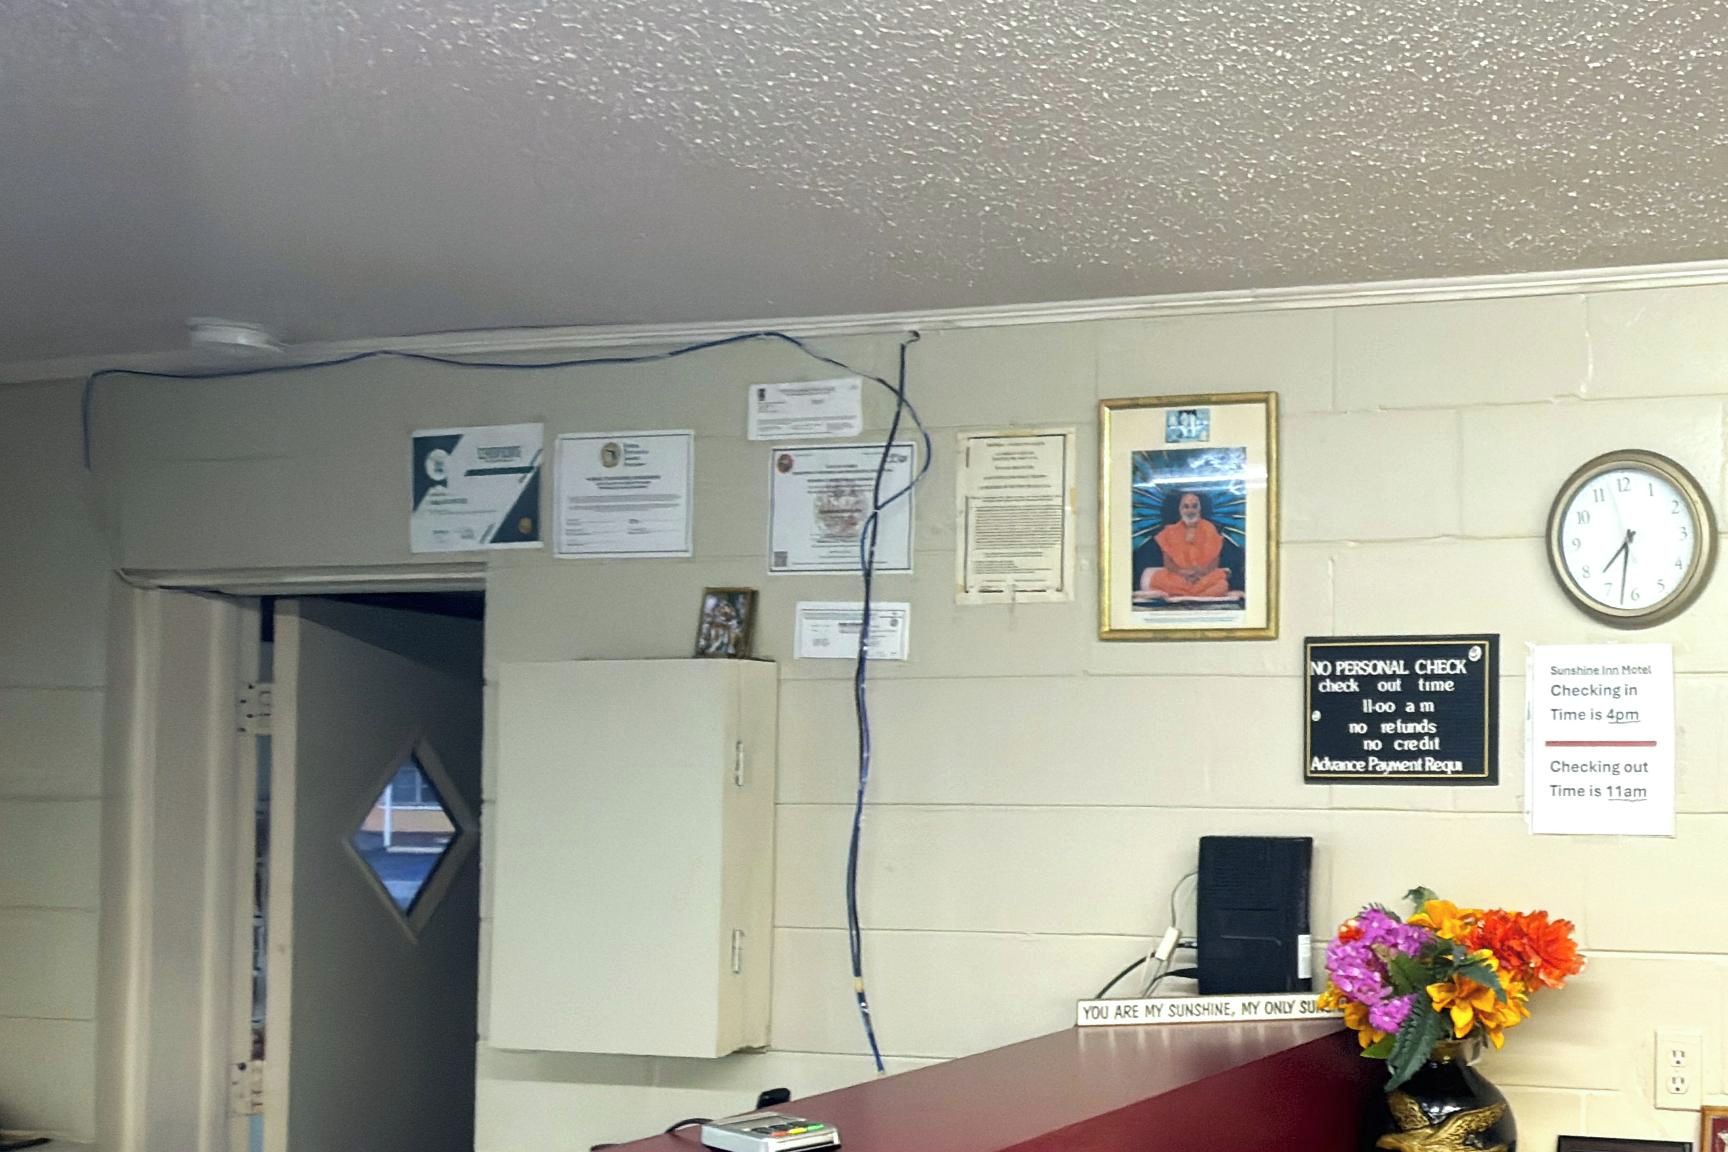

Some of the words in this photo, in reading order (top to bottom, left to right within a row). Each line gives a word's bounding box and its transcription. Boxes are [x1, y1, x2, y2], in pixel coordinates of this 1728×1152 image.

[1617, 477, 1631, 492] 12
[1648, 483, 1654, 497] 1
[1593, 488, 1605, 503] 11
[1671, 500, 1680, 514] 2
[1576, 510, 1591, 524] 10
[1680, 526, 1688, 541] 3
[1572, 537, 1582, 550] 9
[1675, 558, 1683, 570] 4
[1582, 565, 1591, 579] 8
[1604, 582, 1613, 597] 7
[1657, 579, 1665, 591] 5
[1631, 587, 1640, 601] 6
[1311, 661, 1332, 675] NO
[1336, 660, 1409, 675] PERSONAL
[1415, 659, 1467, 675] CHECK
[1550, 665, 1600, 675] Sunshine
[1602, 665, 1619, 675] Inn
[1622, 665, 1652, 675] Motel
[1318, 678, 1360, 693] check
[1377, 679, 1402, 692] out
[1418, 678, 1455, 692] time
[1550, 684, 1621, 699] Checking
[1624, 684, 1638, 696] in
[1405, 702, 1415, 713] a
[1420, 701, 1435, 713] m
[1550, 708, 1586, 721] Time
[1590, 708, 1602, 721] is
[1606, 708, 1639, 723] 4pm
[1349, 722, 1368, 734] no
[1380, 719, 1438, 734] refunds
[1363, 739, 1382, 751] no
[1393, 736, 1440, 750] credit
[1311, 756, 1366, 772] Advance
[1368, 757, 1422, 775] Payment
[1550, 760, 1621, 776] Checking
[1624, 762, 1649, 773] out
[1550, 784, 1585, 797] Time
[1589, 784, 1602, 797] is
[1606, 785, 1647, 798] 11am
[1082, 1006, 1109, 1020] YOU
[1114, 1004, 1139, 1019] ARE
[1145, 1003, 1164, 1018] MY
[1168, 1001, 1236, 1018] SUNSHINE,
[1241, 1001, 1259, 1015] MY
[1264, 1000, 1295, 1015] ONLY
